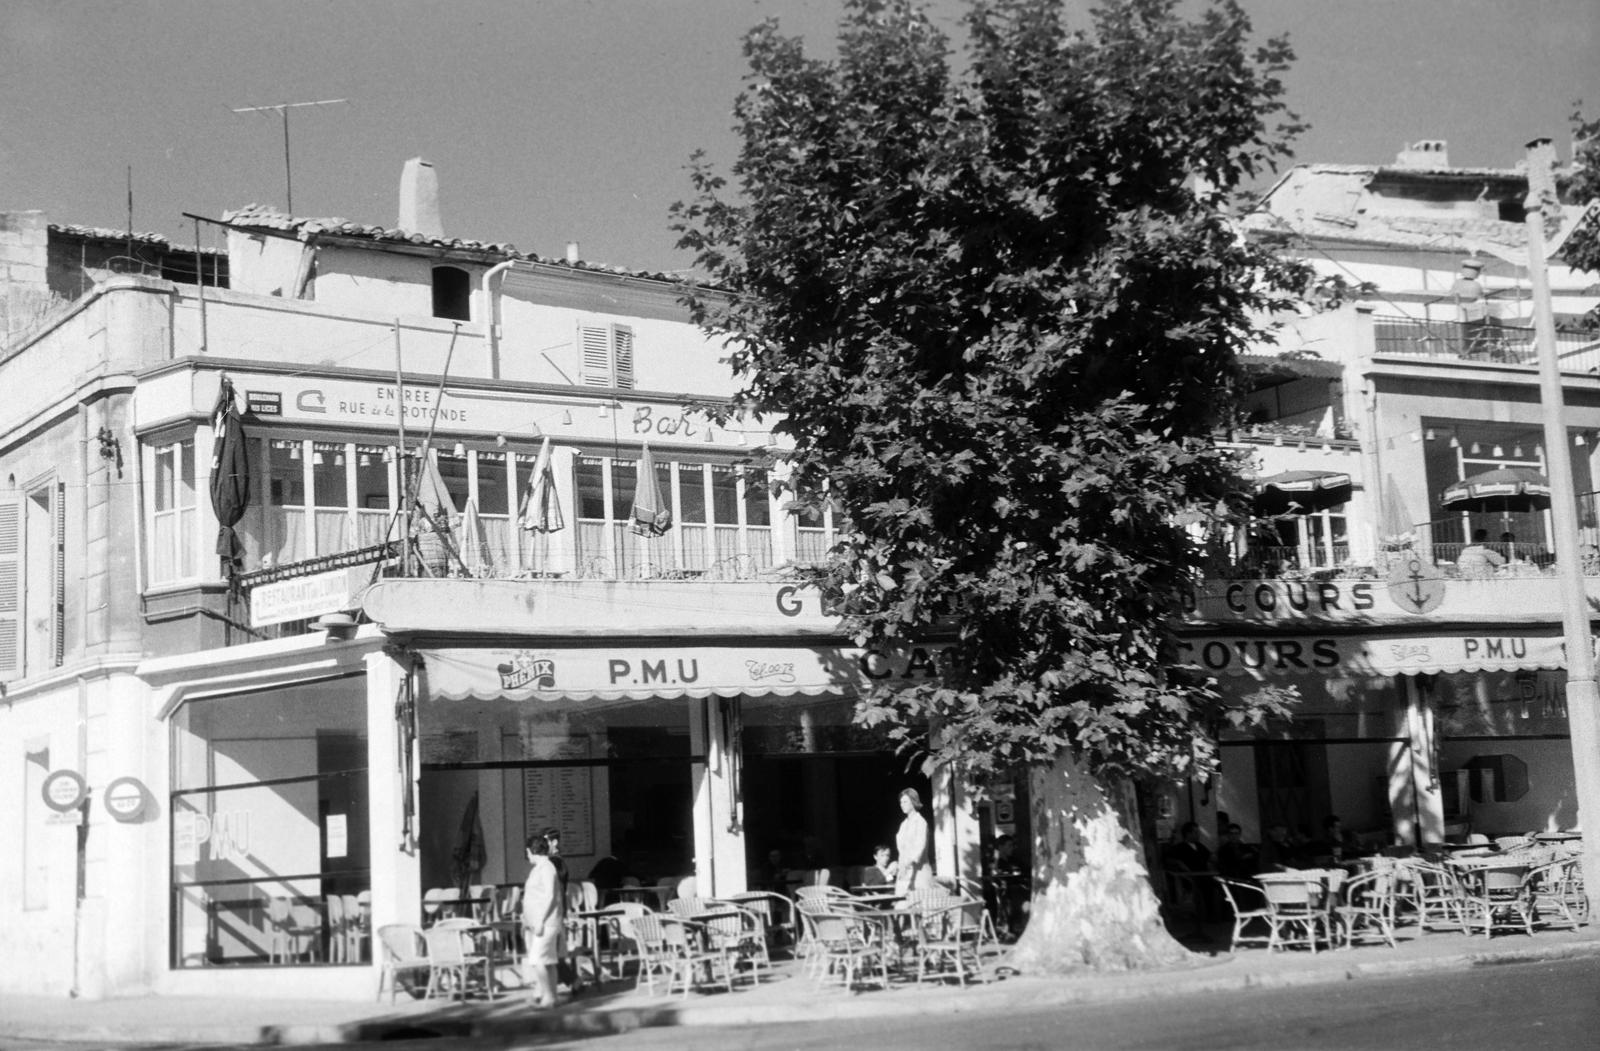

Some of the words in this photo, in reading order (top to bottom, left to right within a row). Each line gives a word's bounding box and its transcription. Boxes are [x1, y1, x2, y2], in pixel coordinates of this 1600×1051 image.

[339, 401, 366, 415] RUE
[401, 405, 467, 422] ROTONDE
[633, 406, 696, 436] Bar
[1226, 582, 1375, 613] COURS
[1463, 638, 1527, 659] P.M.U
[607, 658, 699, 684] P.M.U
